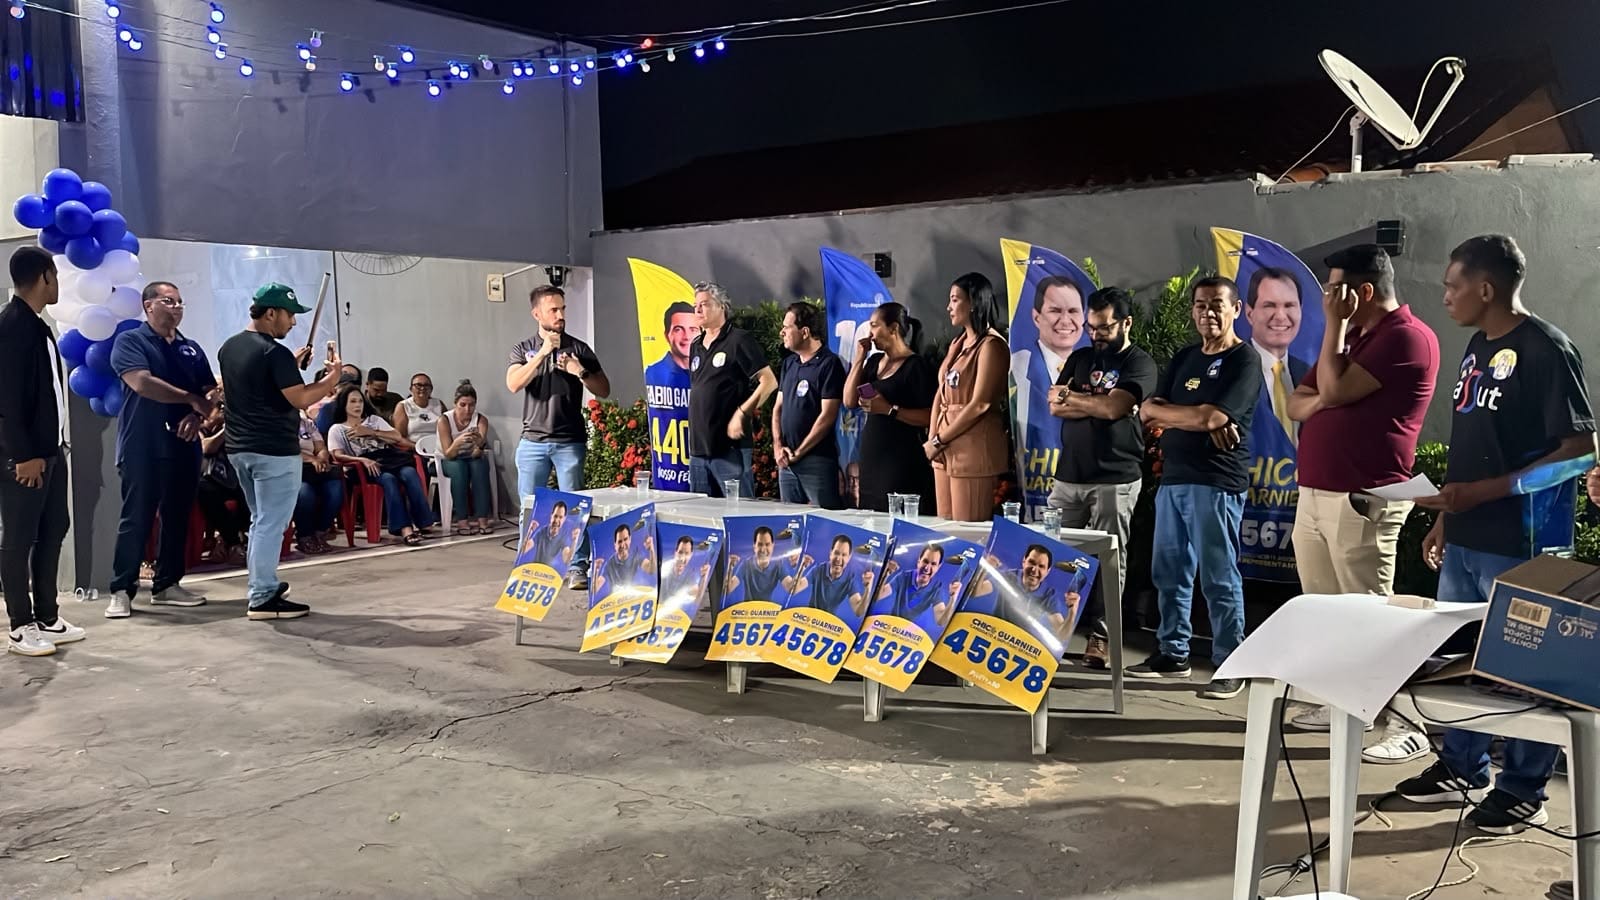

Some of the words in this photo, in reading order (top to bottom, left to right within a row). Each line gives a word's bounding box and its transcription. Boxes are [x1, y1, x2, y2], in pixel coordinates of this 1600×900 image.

[1024, 447, 1060, 476] HI
[1248, 455, 1299, 487] HIC
[506, 580, 556, 607] 45678
[714, 622, 774, 646] 4567
[771, 624, 847, 666] 45678
[997, 631, 1042, 656] GUARNIERI
[1503, 627, 1532, 641] COPOS
[1533, 629, 1545, 637] DE
[853, 631, 924, 674] 45678
[943, 628, 1048, 693] 45678
